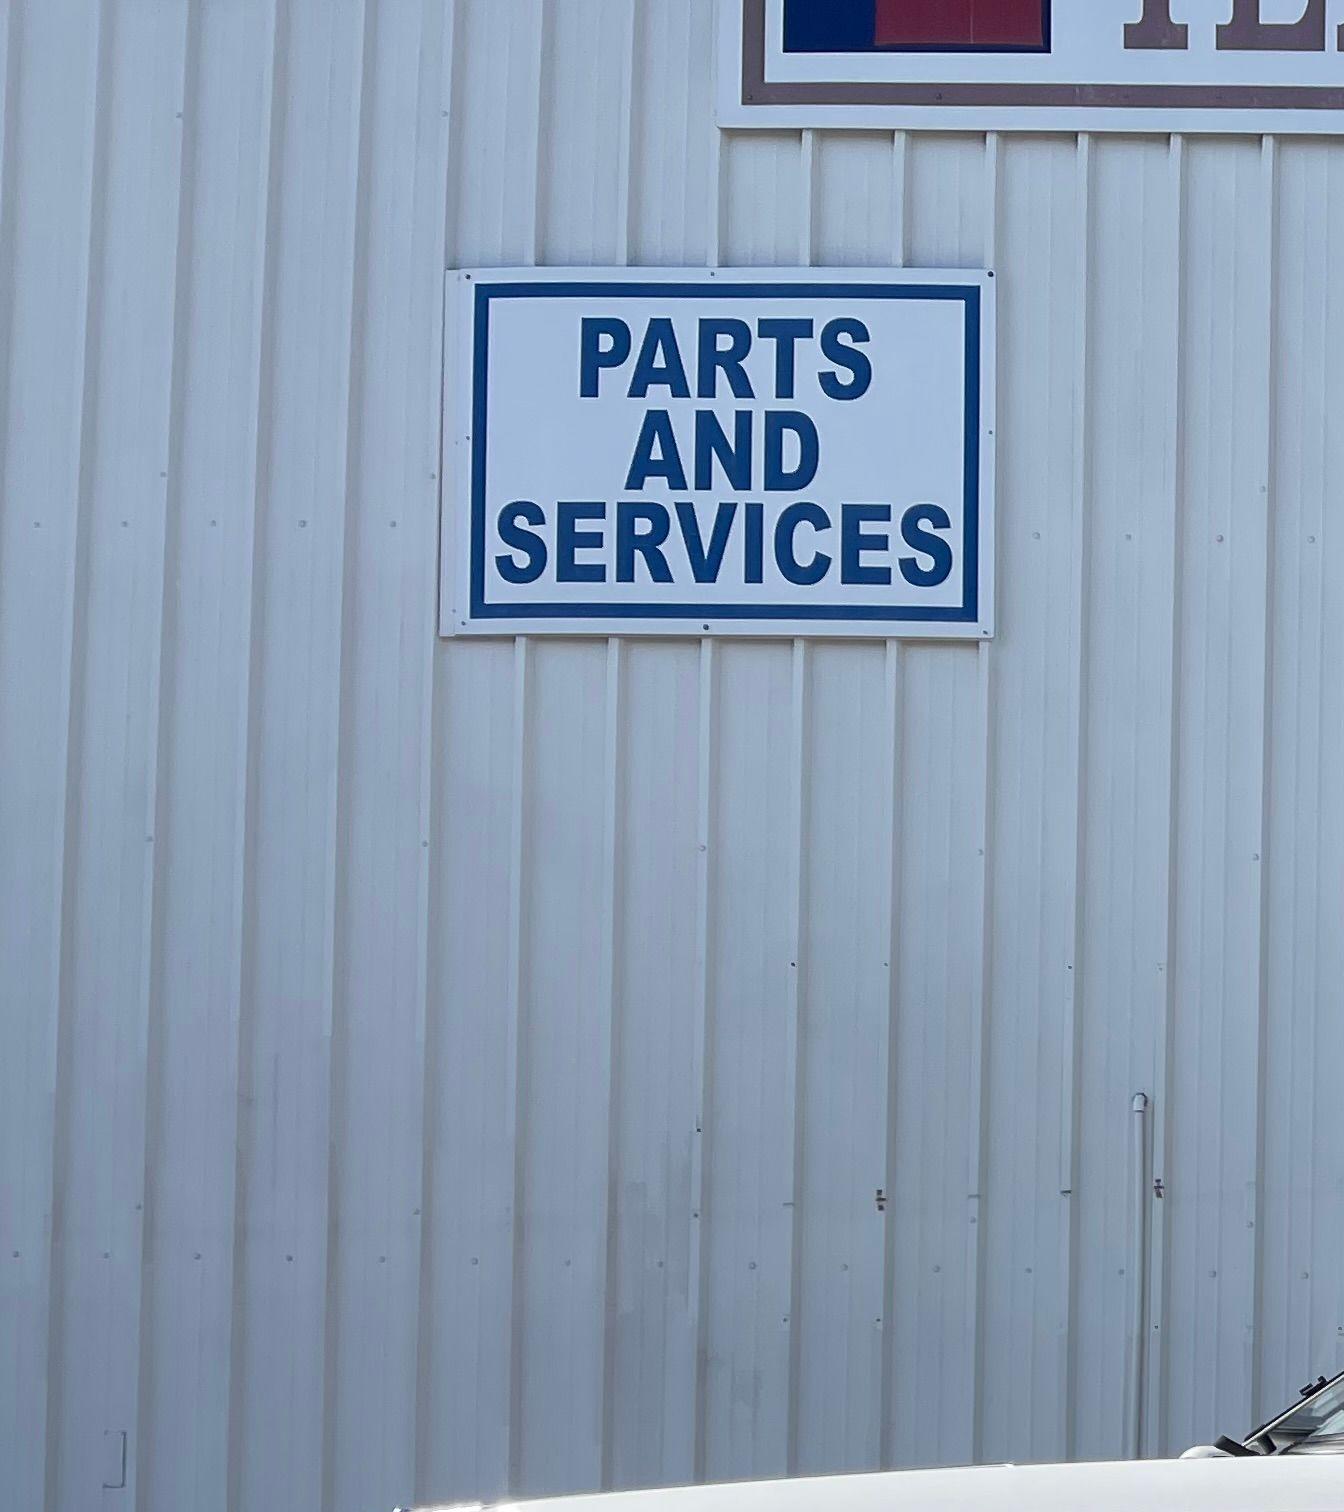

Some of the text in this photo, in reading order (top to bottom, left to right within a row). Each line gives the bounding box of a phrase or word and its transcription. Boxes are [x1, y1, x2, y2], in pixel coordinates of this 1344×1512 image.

[580, 316, 872, 400] PARTS
[624, 409, 820, 492] AND
[495, 500, 953, 588] SERVICES
